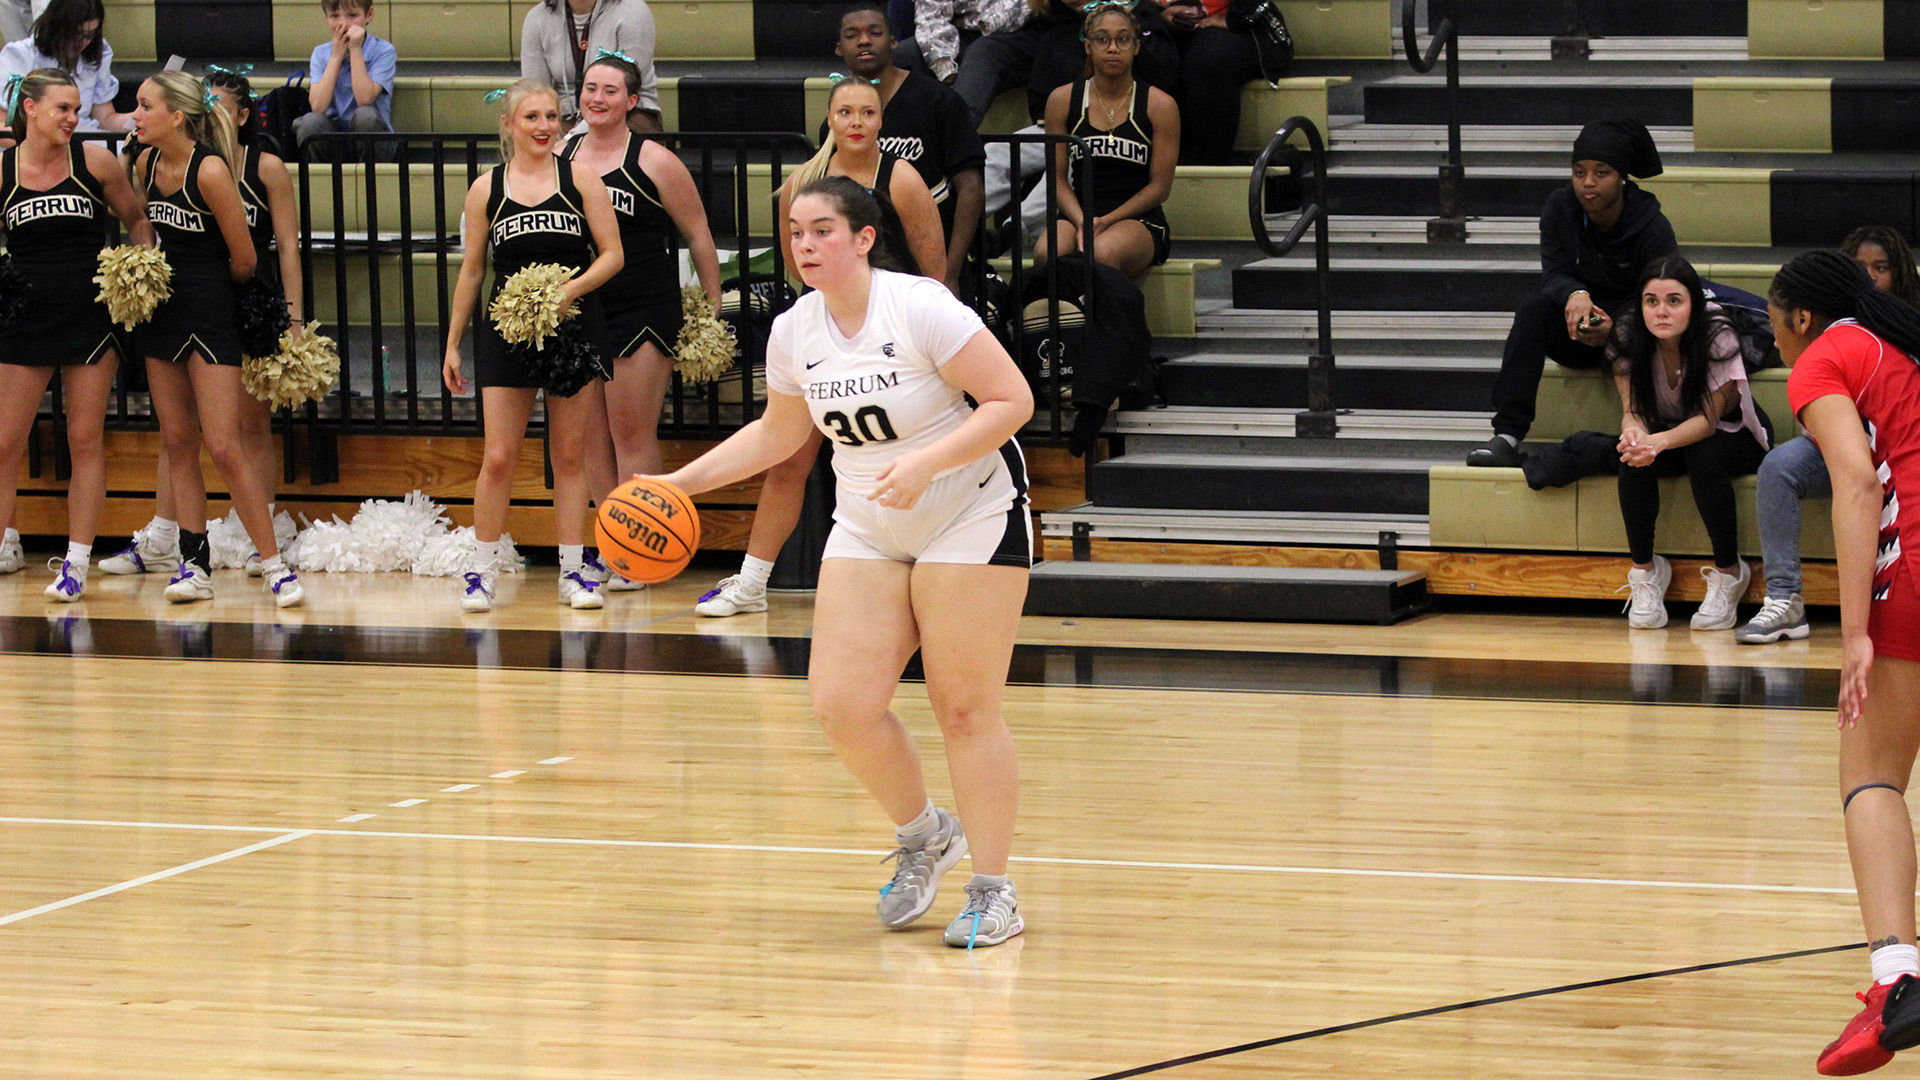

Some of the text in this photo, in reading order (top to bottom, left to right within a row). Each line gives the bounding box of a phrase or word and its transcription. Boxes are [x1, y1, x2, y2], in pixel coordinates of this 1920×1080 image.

[6, 194, 94, 231] FERRUM
[148, 201, 205, 232] ERRUM
[493, 210, 582, 246] FERRUM
[809, 371, 900, 399] FERRUM
[823, 404, 898, 446] 30
[631, 486, 679, 519] NCAA
[608, 505, 668, 554] Wilson
